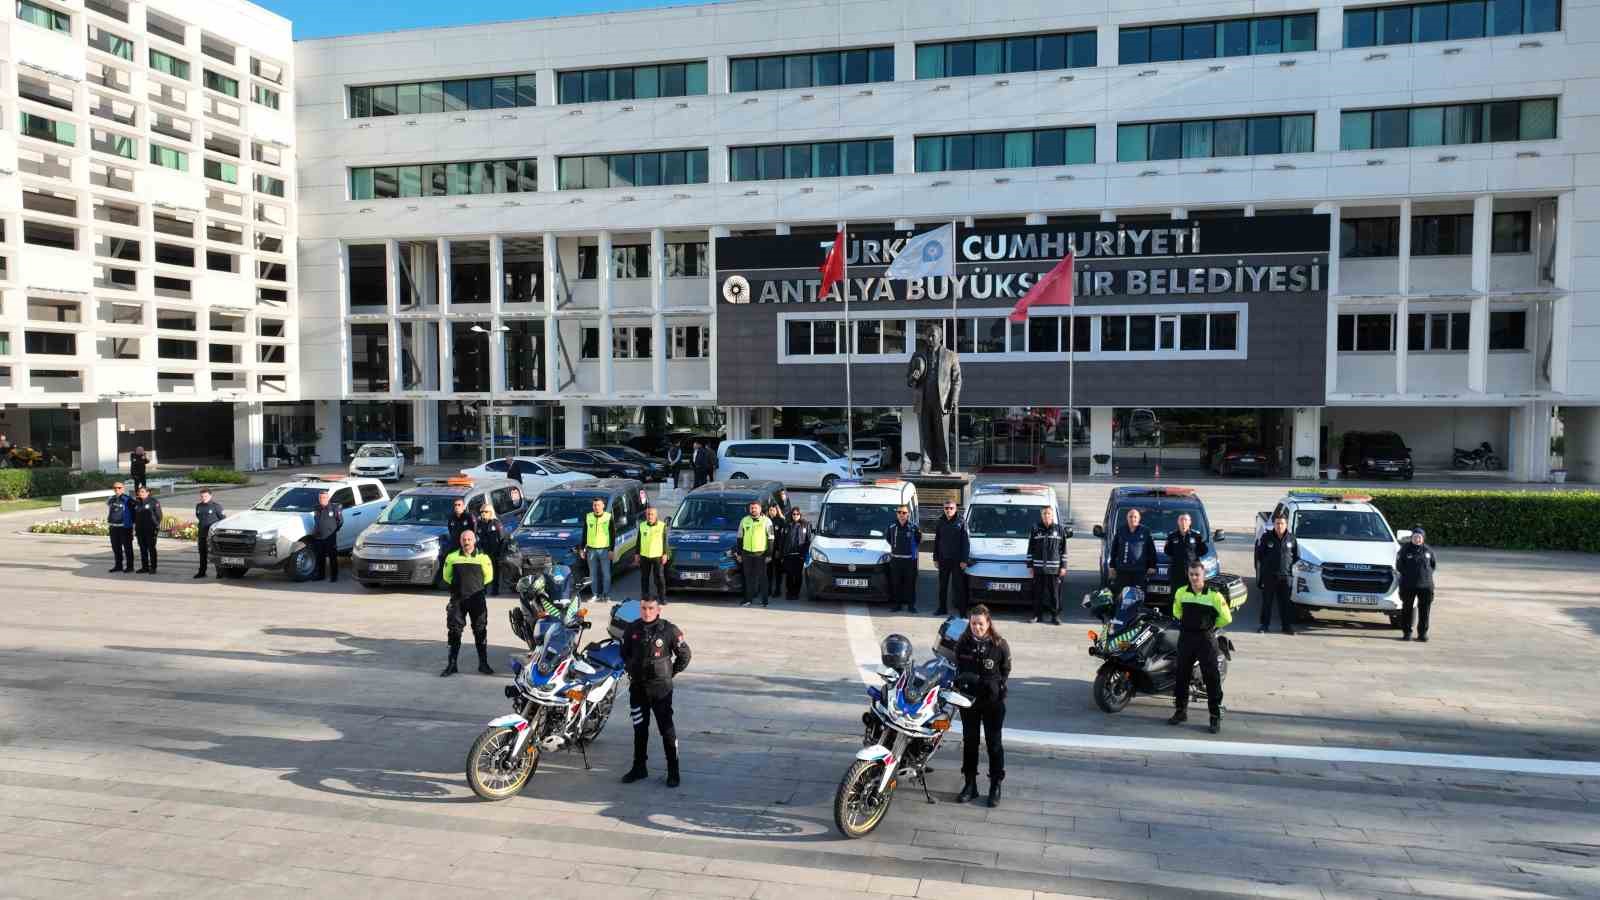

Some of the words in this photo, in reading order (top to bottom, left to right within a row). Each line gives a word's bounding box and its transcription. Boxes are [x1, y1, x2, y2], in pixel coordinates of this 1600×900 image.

[962, 220, 1201, 261] CUMHURİYETİ
[758, 276, 896, 304] ANTALYA
[1126, 257, 1319, 295] BELEDİYESİ
